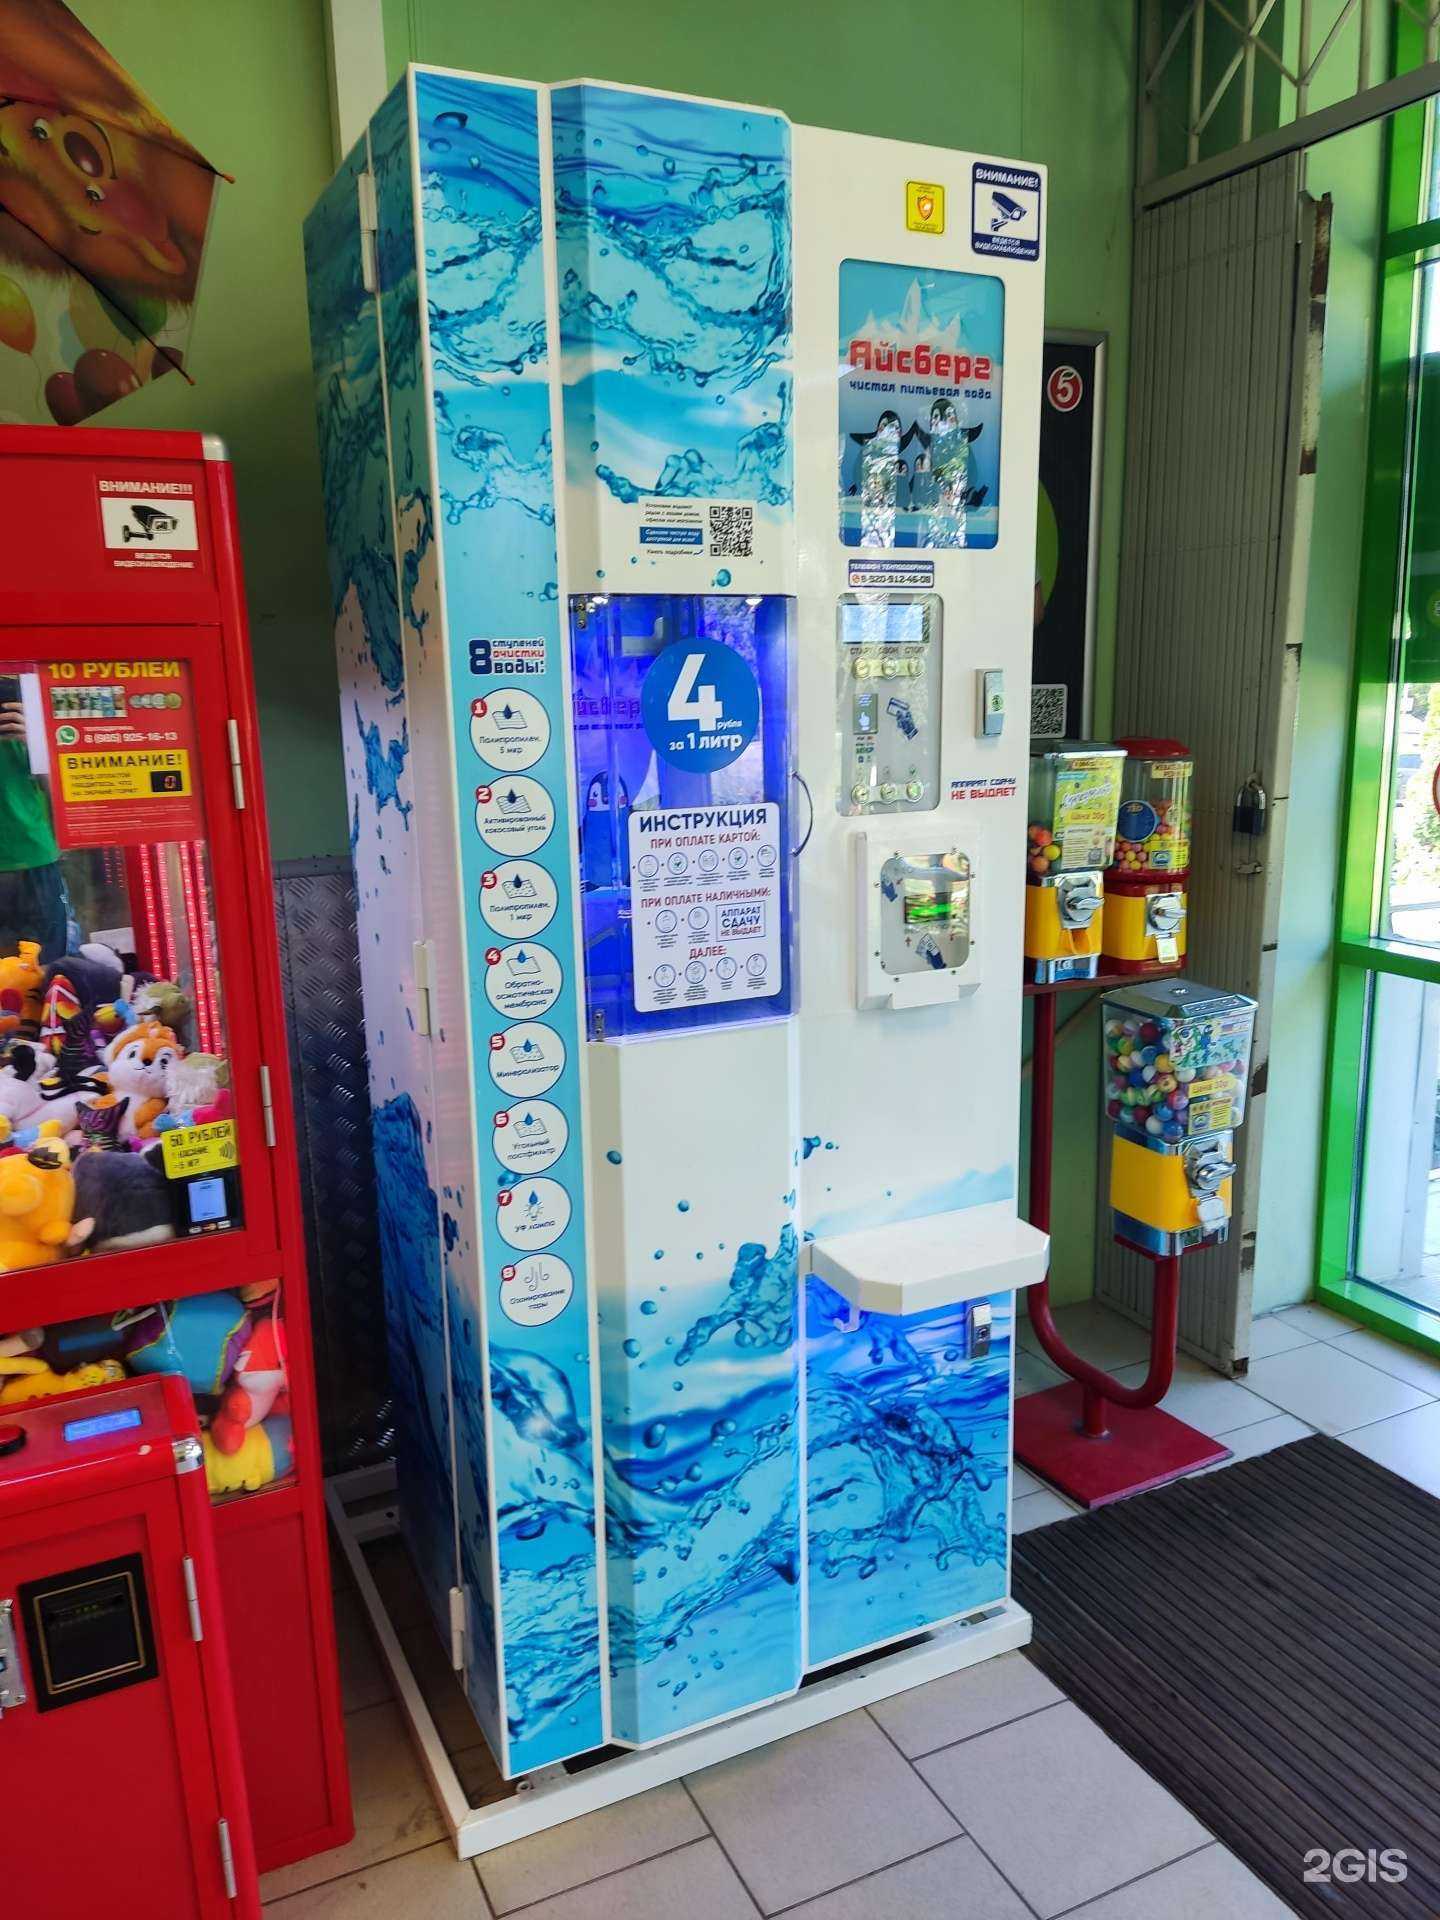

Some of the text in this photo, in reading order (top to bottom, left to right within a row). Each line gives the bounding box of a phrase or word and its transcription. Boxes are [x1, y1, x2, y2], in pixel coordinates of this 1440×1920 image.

[976, 168, 1039, 188] ВНИМАНИЕ!
[849, 380, 992, 399] чистая питьевая вода
[99, 480, 193, 495] ВНИМАНИЕ!!!
[468, 638, 545, 674] 8 ступеней
[492, 650, 545, 659] очистки
[48, 662, 76, 679] 10
[494, 659, 545, 674] воды:
[667, 653, 723, 731] 4
[474, 701, 484, 714] 1
[669, 732, 743, 752] за 1 литр
[66, 753, 183, 770] ВНИМАНИЕ!
[477, 788, 490, 800] 2
[951, 786, 1017, 800] НЕ ВЫДАЕТ
[640, 808, 767, 833] ИНСТРУКЦИЯ
[650, 829, 761, 849] ПРИ ОПЛАТЕ КАРТОЙ:
[483, 873, 495, 886] 3
[640, 886, 772, 909] ПРИ ОПЛАТЕ НАЛИЧНЫМИ:
[720, 905, 761, 918] АППАРАТ
[721, 915, 761, 929] СДАЧУ
[720, 929, 731, 937] НЕ
[487, 949, 499, 962] 4
[491, 1035, 503, 1048] 5
[499, 1192, 510, 1204] 7
